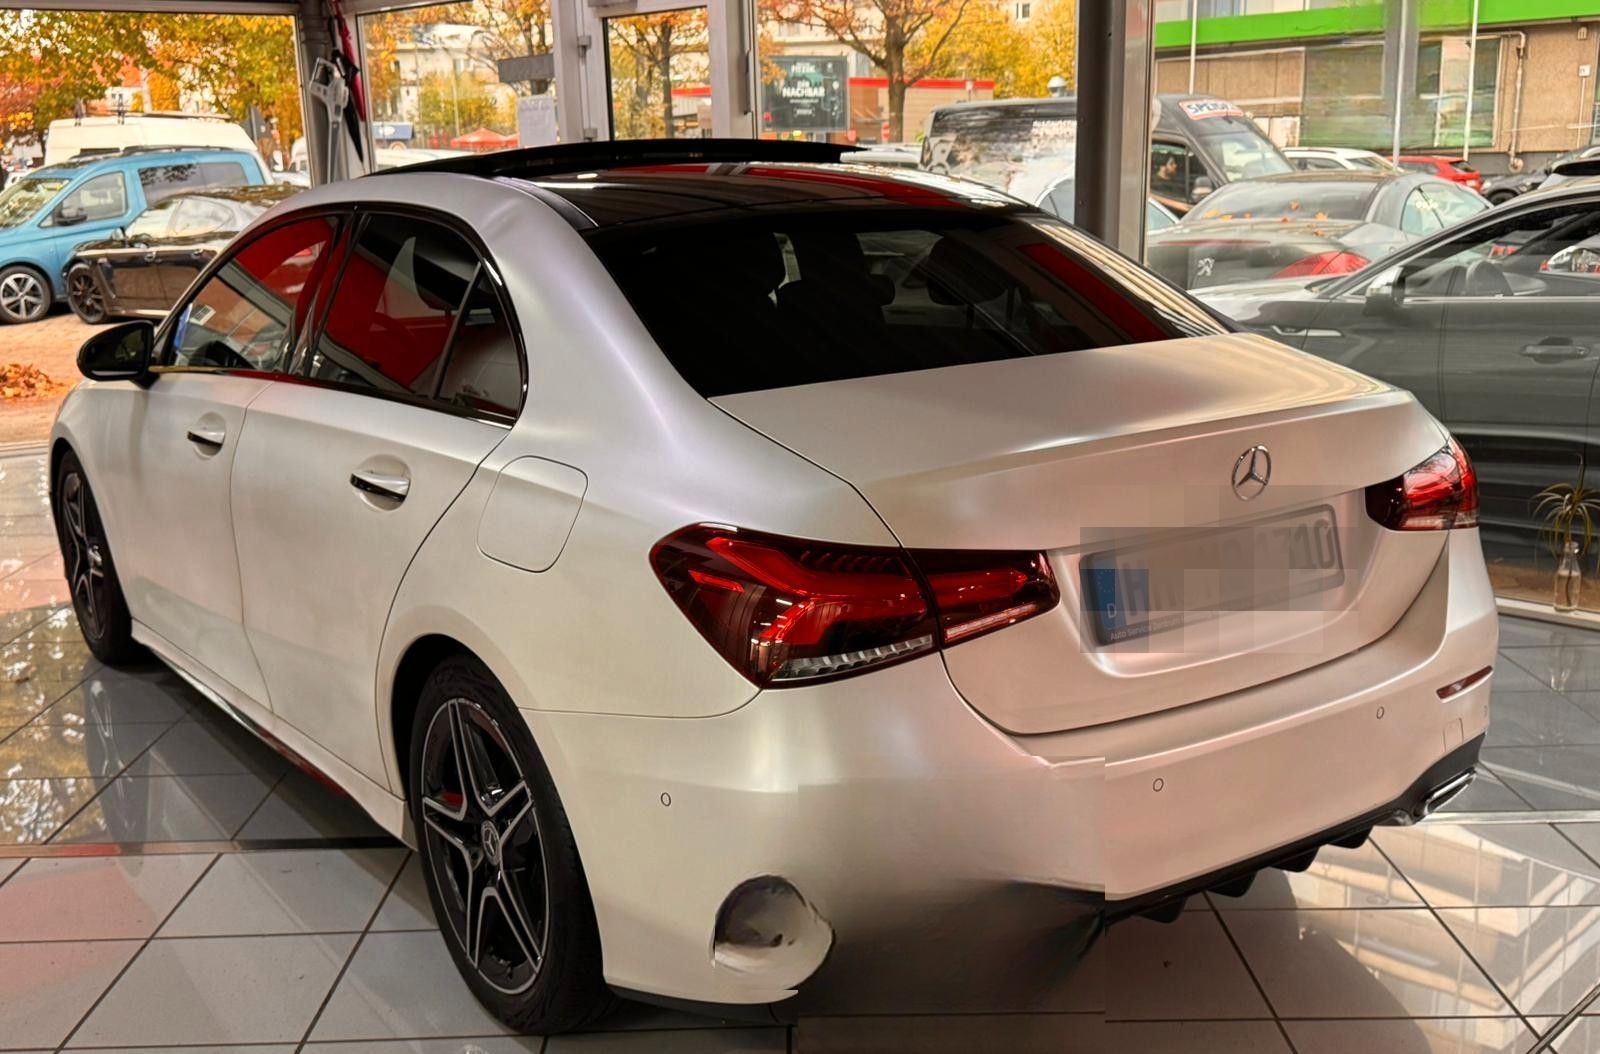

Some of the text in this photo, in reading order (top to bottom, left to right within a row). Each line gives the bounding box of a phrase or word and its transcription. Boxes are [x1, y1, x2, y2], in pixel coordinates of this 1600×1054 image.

[782, 86, 825, 97] NACHBAR
[1107, 603, 1117, 619] D
[1110, 629, 1127, 640] Auto
[1128, 624, 1151, 636] Service
[1153, 616, 1181, 630] Zentrum
